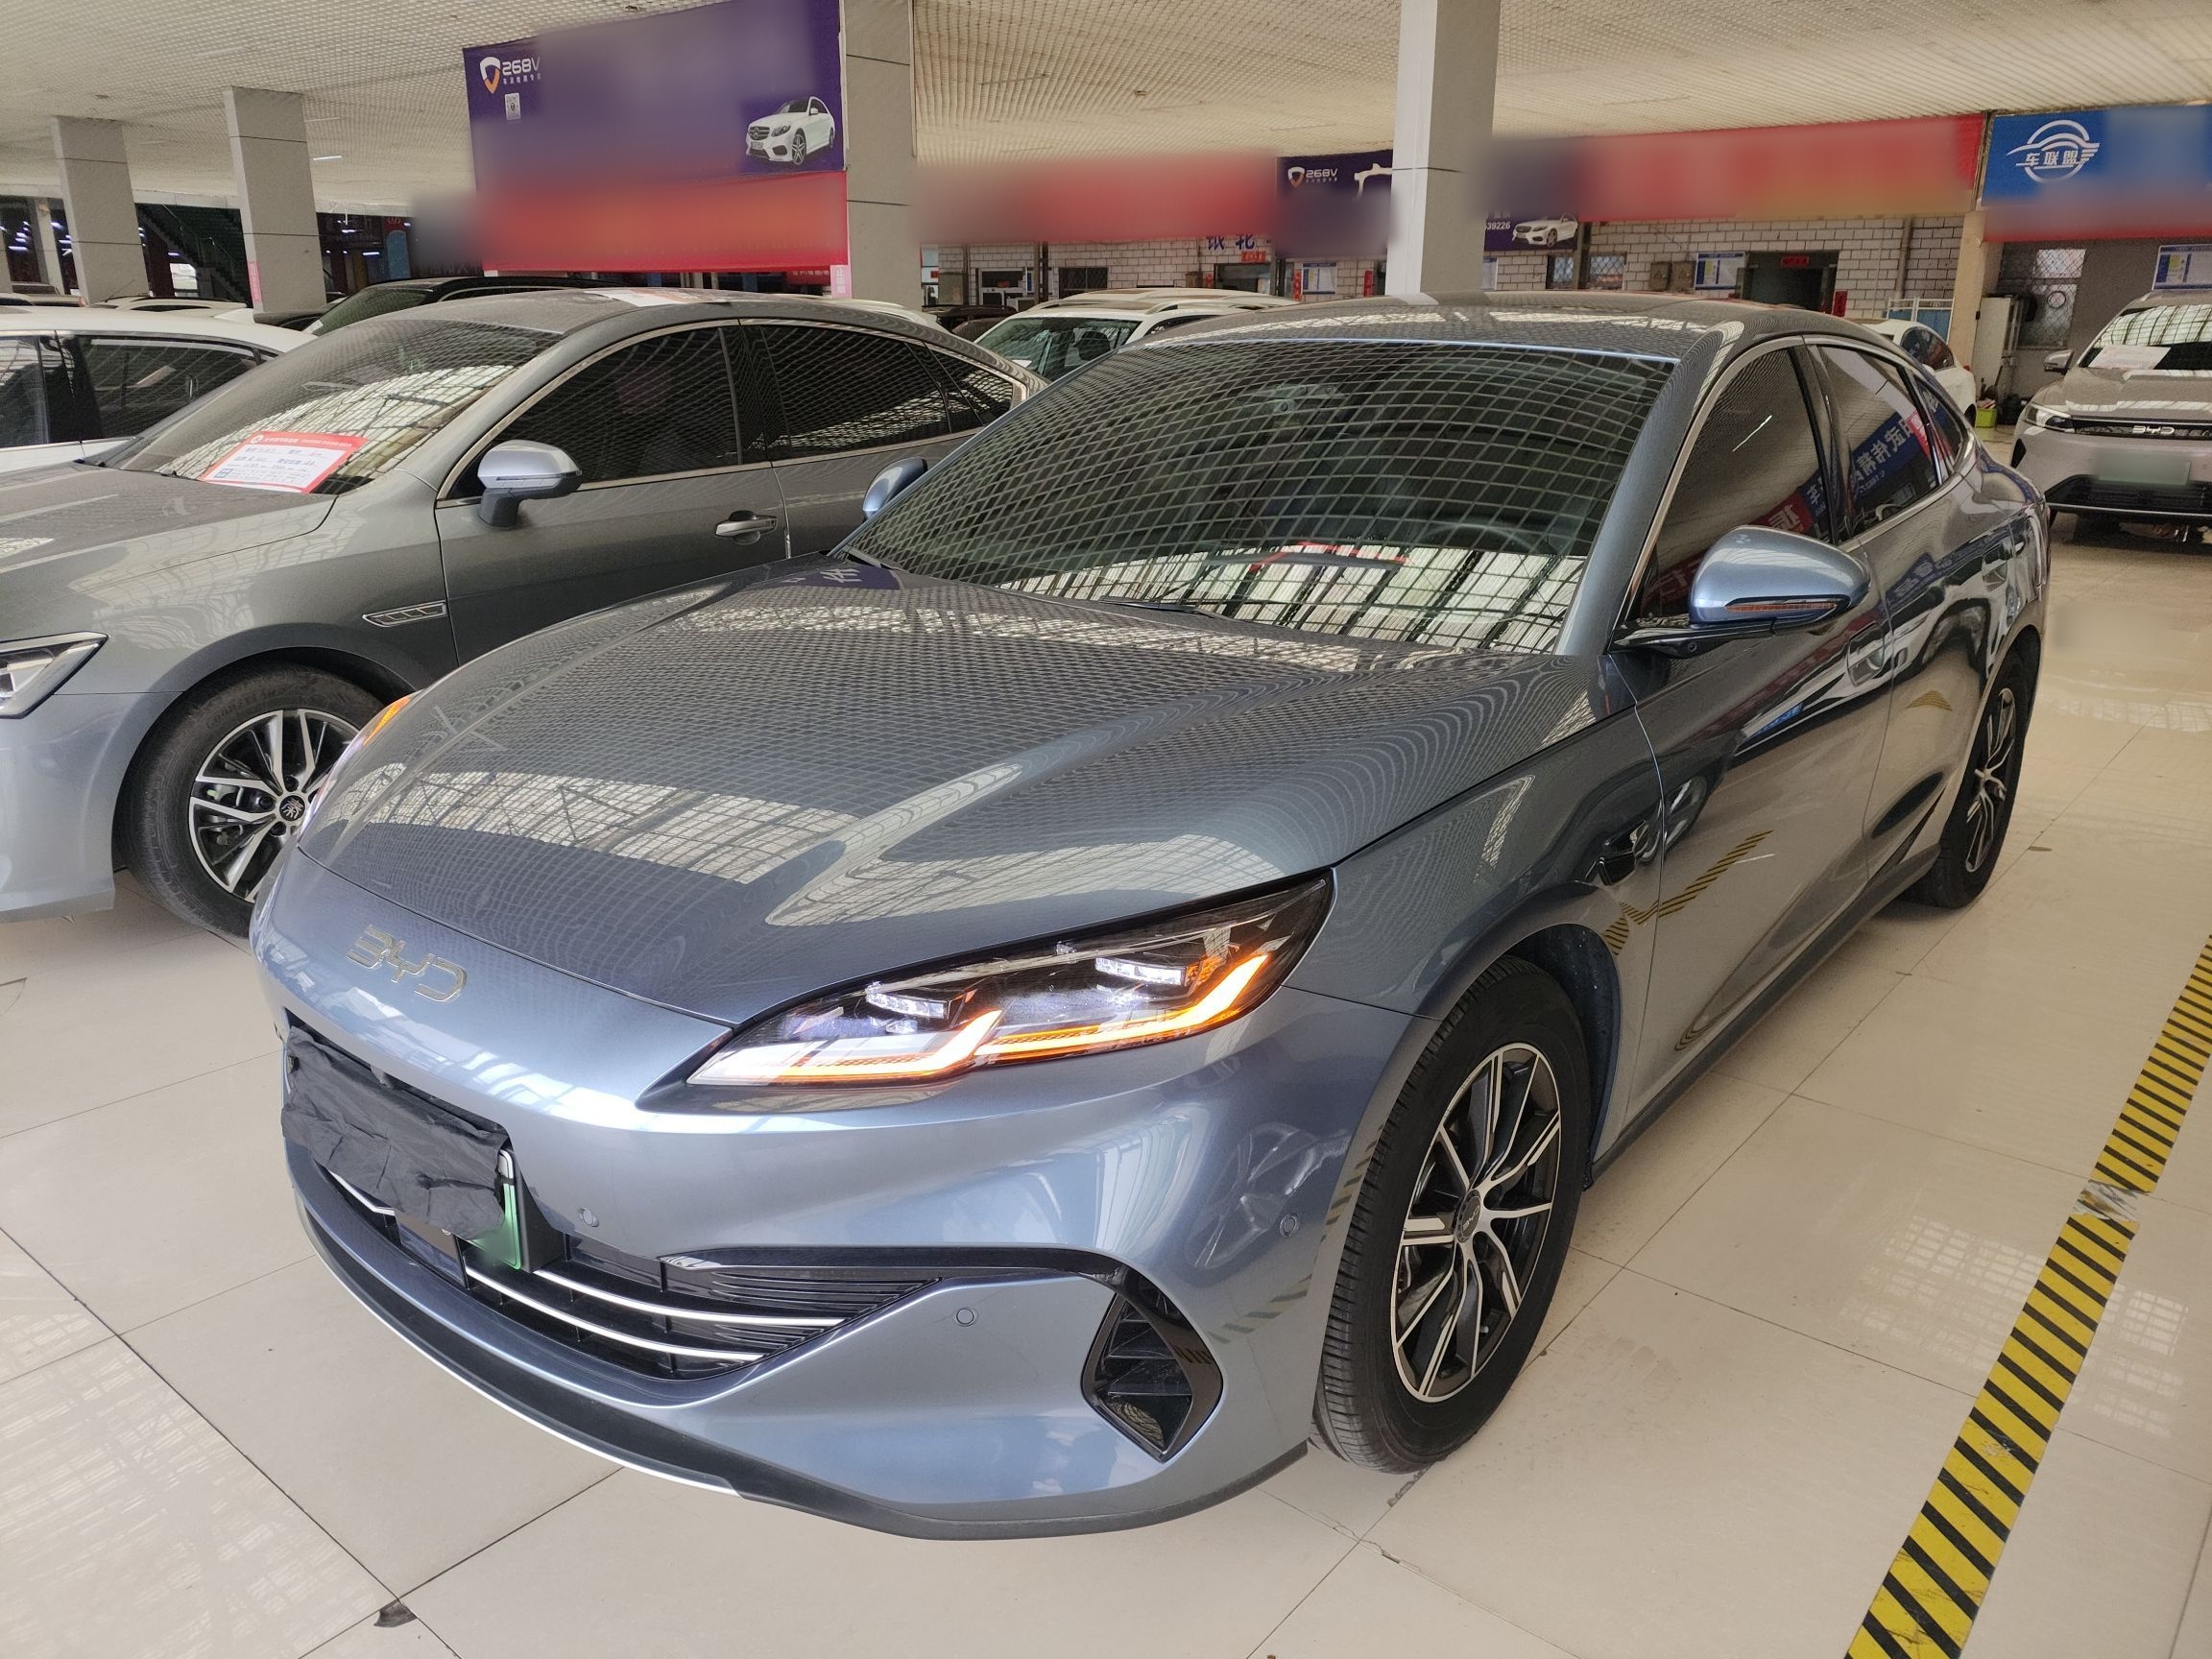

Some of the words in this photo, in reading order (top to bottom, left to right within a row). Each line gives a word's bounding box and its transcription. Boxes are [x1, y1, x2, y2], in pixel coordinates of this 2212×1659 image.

[502, 57, 541, 76] 268V
[2024, 150, 2080, 166] 车联盟
[1306, 168, 1338, 179] 268V
[1485, 221, 1511, 230] 39226
[2132, 425, 2175, 435] BYD
[346, 925, 468, 1002] BYD
